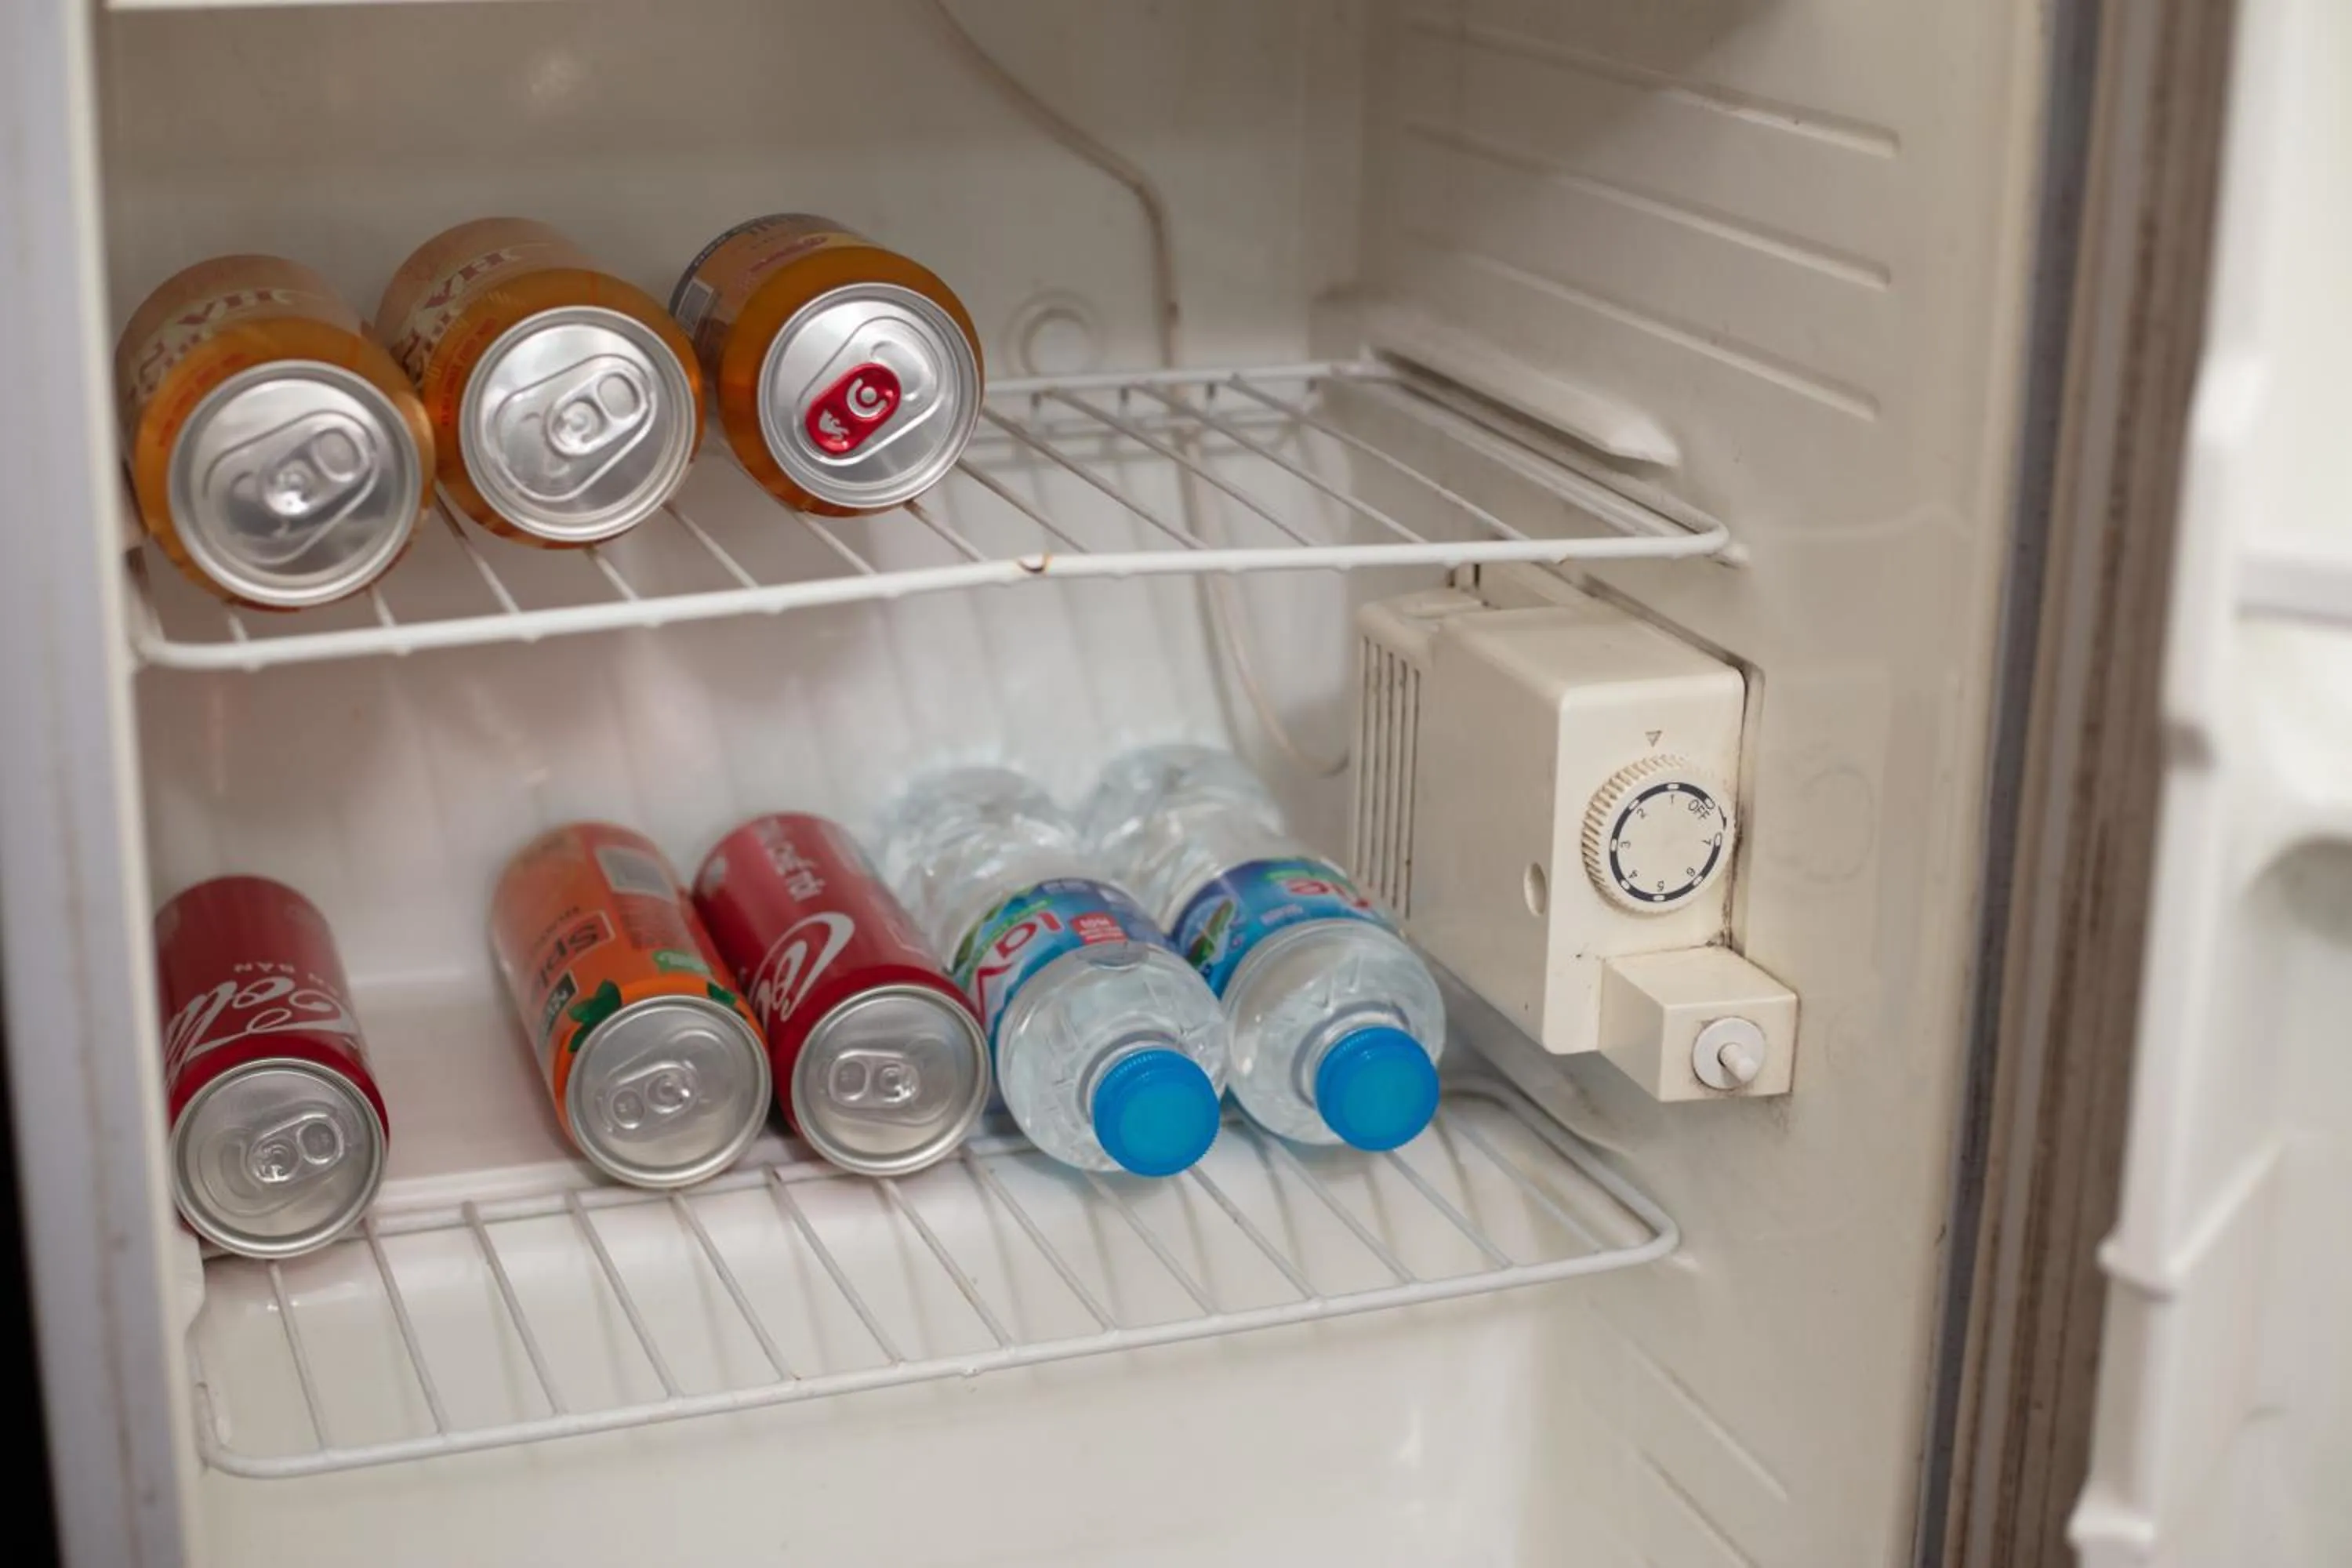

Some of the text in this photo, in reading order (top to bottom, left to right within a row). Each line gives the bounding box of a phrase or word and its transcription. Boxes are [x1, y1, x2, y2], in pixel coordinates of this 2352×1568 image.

[1636, 808, 1646, 819] 2
[1688, 799, 1710, 820] OFF
[1621, 840, 1632, 848] 3
[1628, 869, 1638, 879] 4
[1657, 880, 1664, 891] 5
